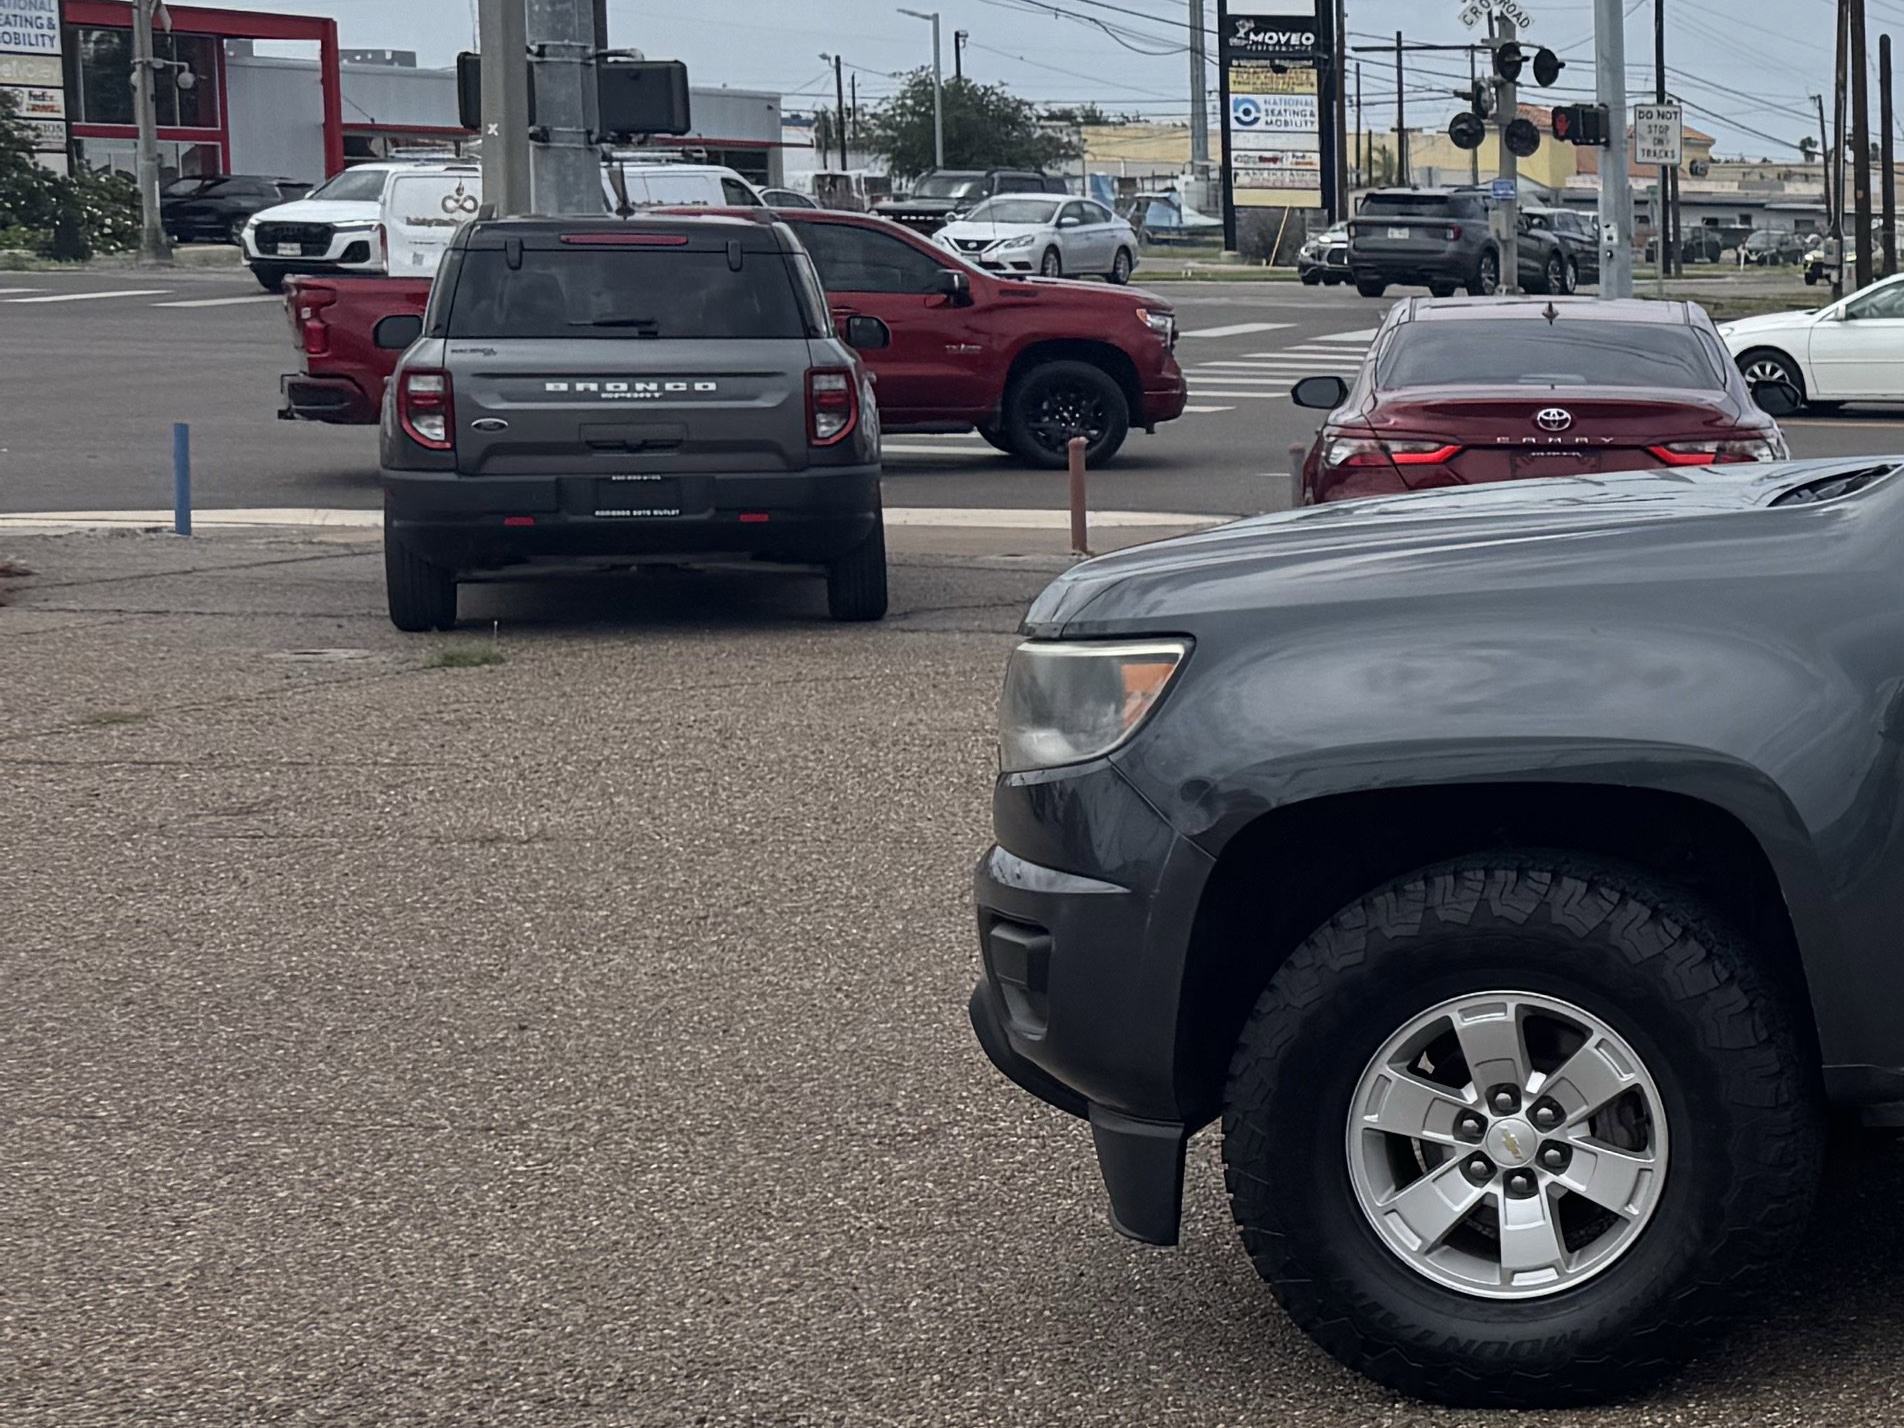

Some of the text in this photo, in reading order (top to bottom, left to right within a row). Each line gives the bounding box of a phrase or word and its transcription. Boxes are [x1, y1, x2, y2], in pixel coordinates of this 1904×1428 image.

[0, 31, 56, 48] OBILITY
[1249, 32, 1315, 46] MOVEO
[1264, 108, 1307, 118] SEATING
[1637, 110, 1679, 121] DO NOT
[1264, 119, 1315, 128] MOBILITY
[1647, 124, 1670, 134] STOP
[1641, 148, 1675, 159] TRACKS
[545, 382, 717, 391] BRONCO
